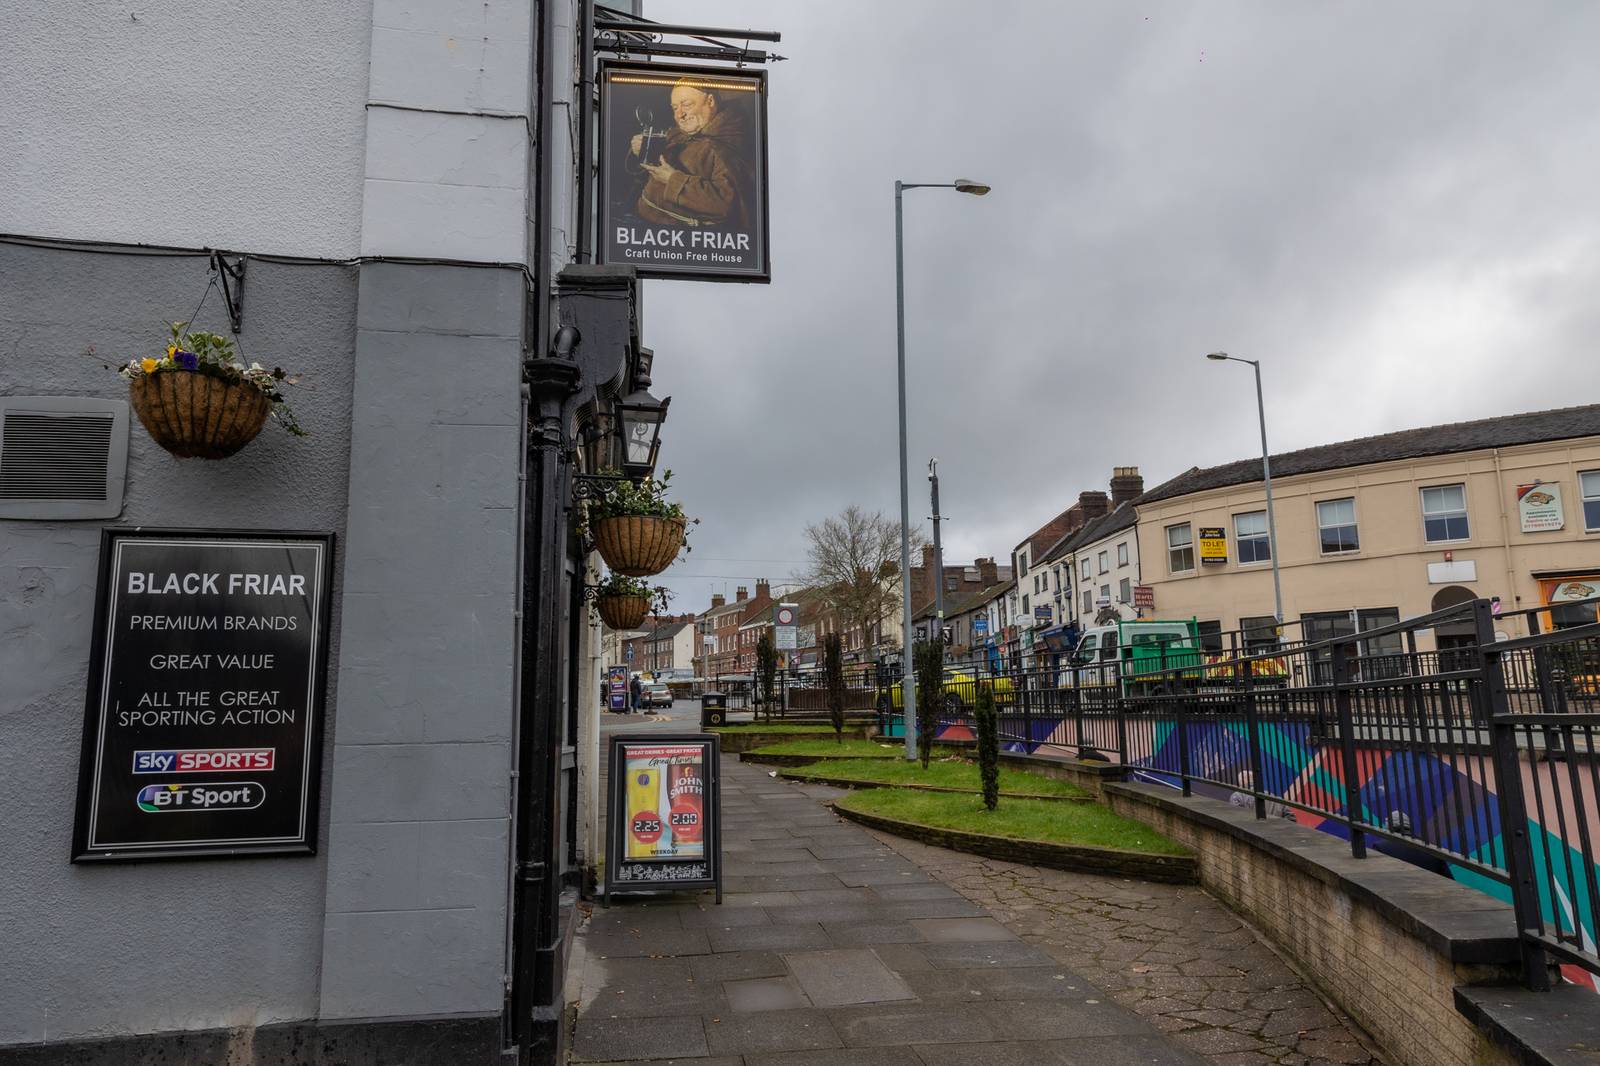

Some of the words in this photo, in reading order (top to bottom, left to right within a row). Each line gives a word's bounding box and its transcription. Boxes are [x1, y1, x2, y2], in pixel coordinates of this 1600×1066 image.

[616, 227, 685, 248] BLACK
[691, 231, 750, 250] FRIAR
[625, 249, 650, 259] Craft
[653, 250, 683, 260] Union
[686, 251, 708, 261] Free
[711, 253, 742, 263] House
[127, 572, 220, 595] BLACK
[228, 574, 306, 596] FRIAR
[130, 615, 218, 631] PREMIUM
[223, 616, 298, 631] BRANDS
[149, 654, 212, 669] GREAT
[216, 654, 274, 669] VALUE
[137, 692, 172, 708] ALL
[177, 691, 210, 707] THE
[219, 690, 280, 706] GREAT
[118, 710, 216, 727] SPORTING
[221, 709, 295, 725] ACTION
[138, 752, 174, 771] sky
[180, 752, 269, 769] SPORTS
[674, 777, 703, 788] JOHN
[153, 790, 189, 806] BT
[191, 787, 250, 807] Sport
[670, 785, 703, 799] SMITH
[634, 820, 660, 832] 2.25
[672, 813, 697, 825] 2.00
